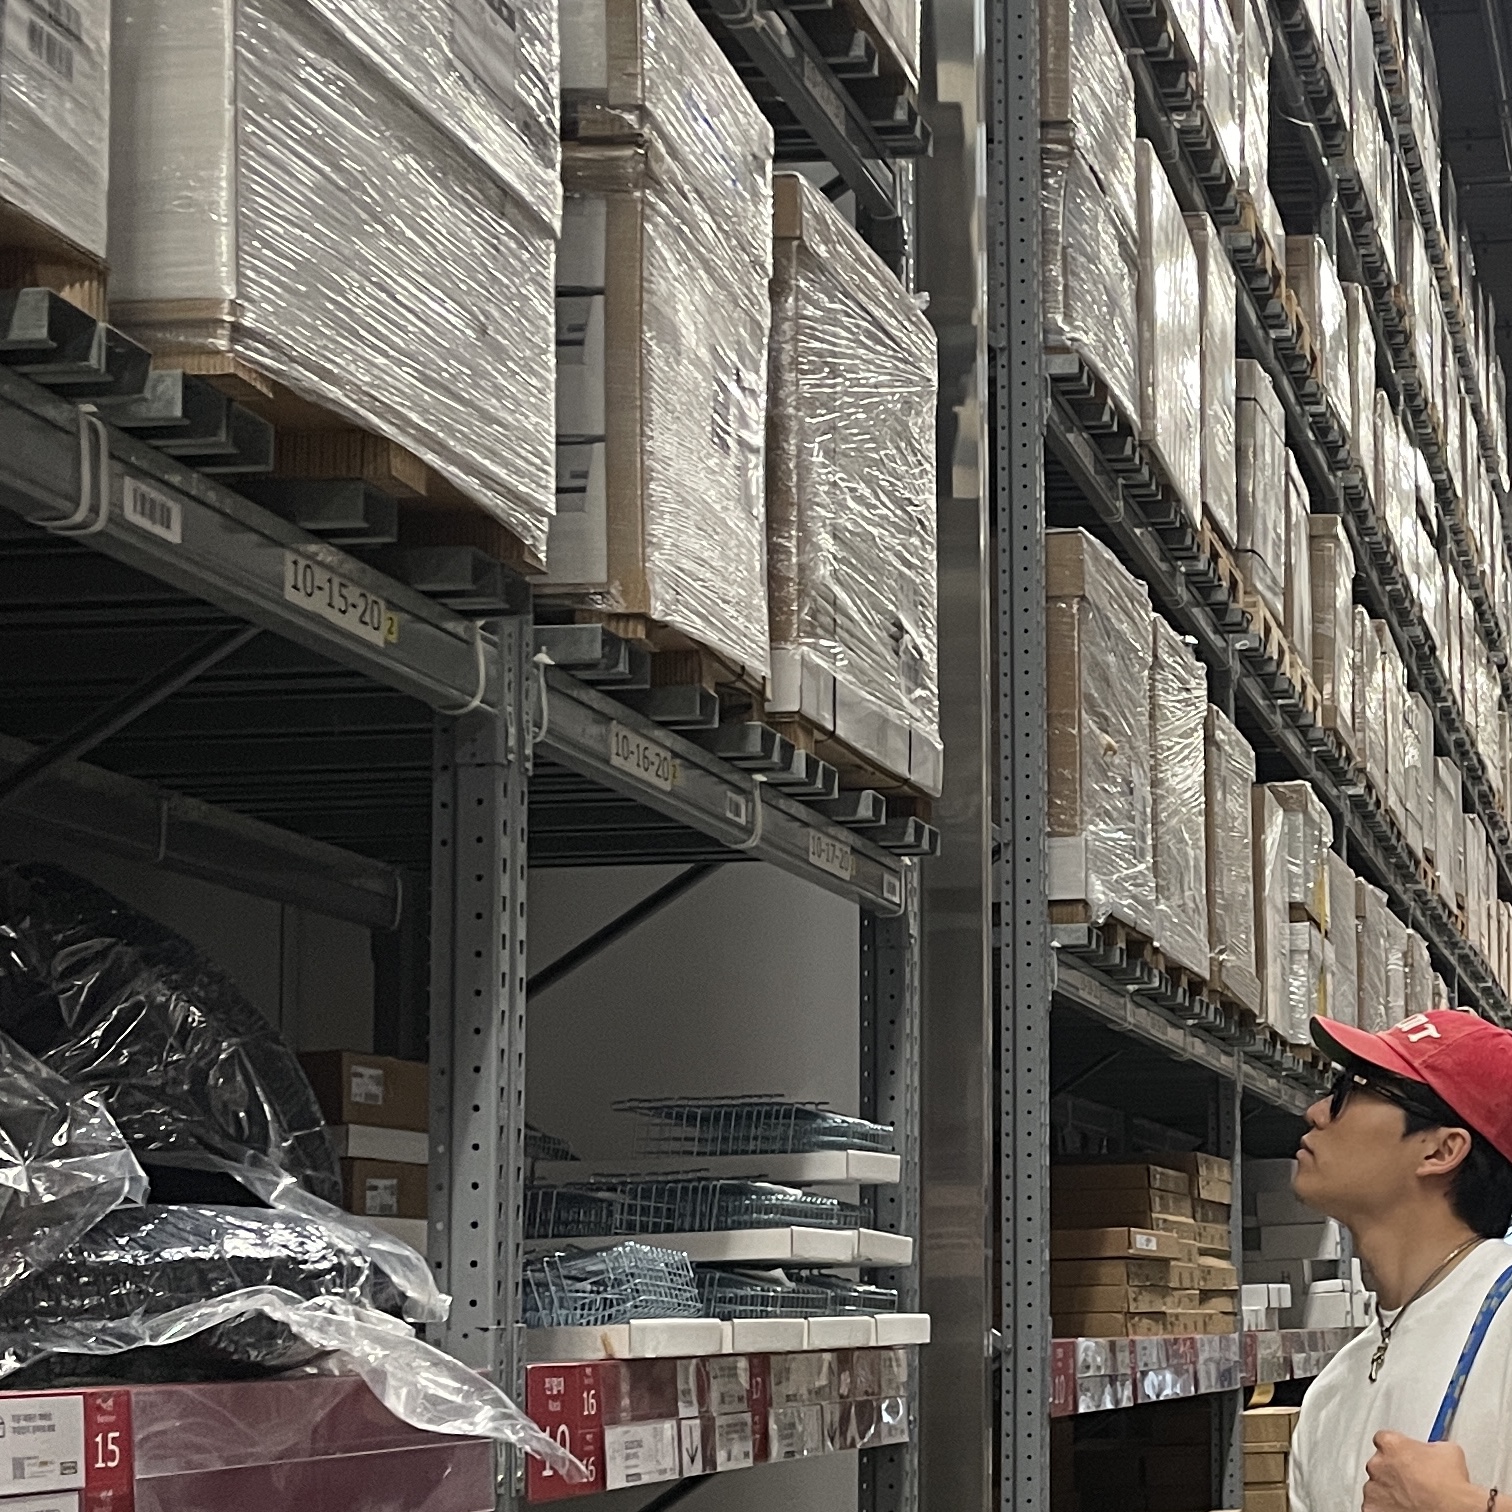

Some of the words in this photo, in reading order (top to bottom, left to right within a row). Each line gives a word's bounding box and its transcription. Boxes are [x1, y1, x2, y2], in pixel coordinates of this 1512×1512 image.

[291, 558, 382, 631] 10-15-20
[387, 616, 395, 635] 2
[614, 731, 670, 782] 10-16-20
[583, 1390, 597, 1415] 16
[94, 1432, 120, 1469] 15
